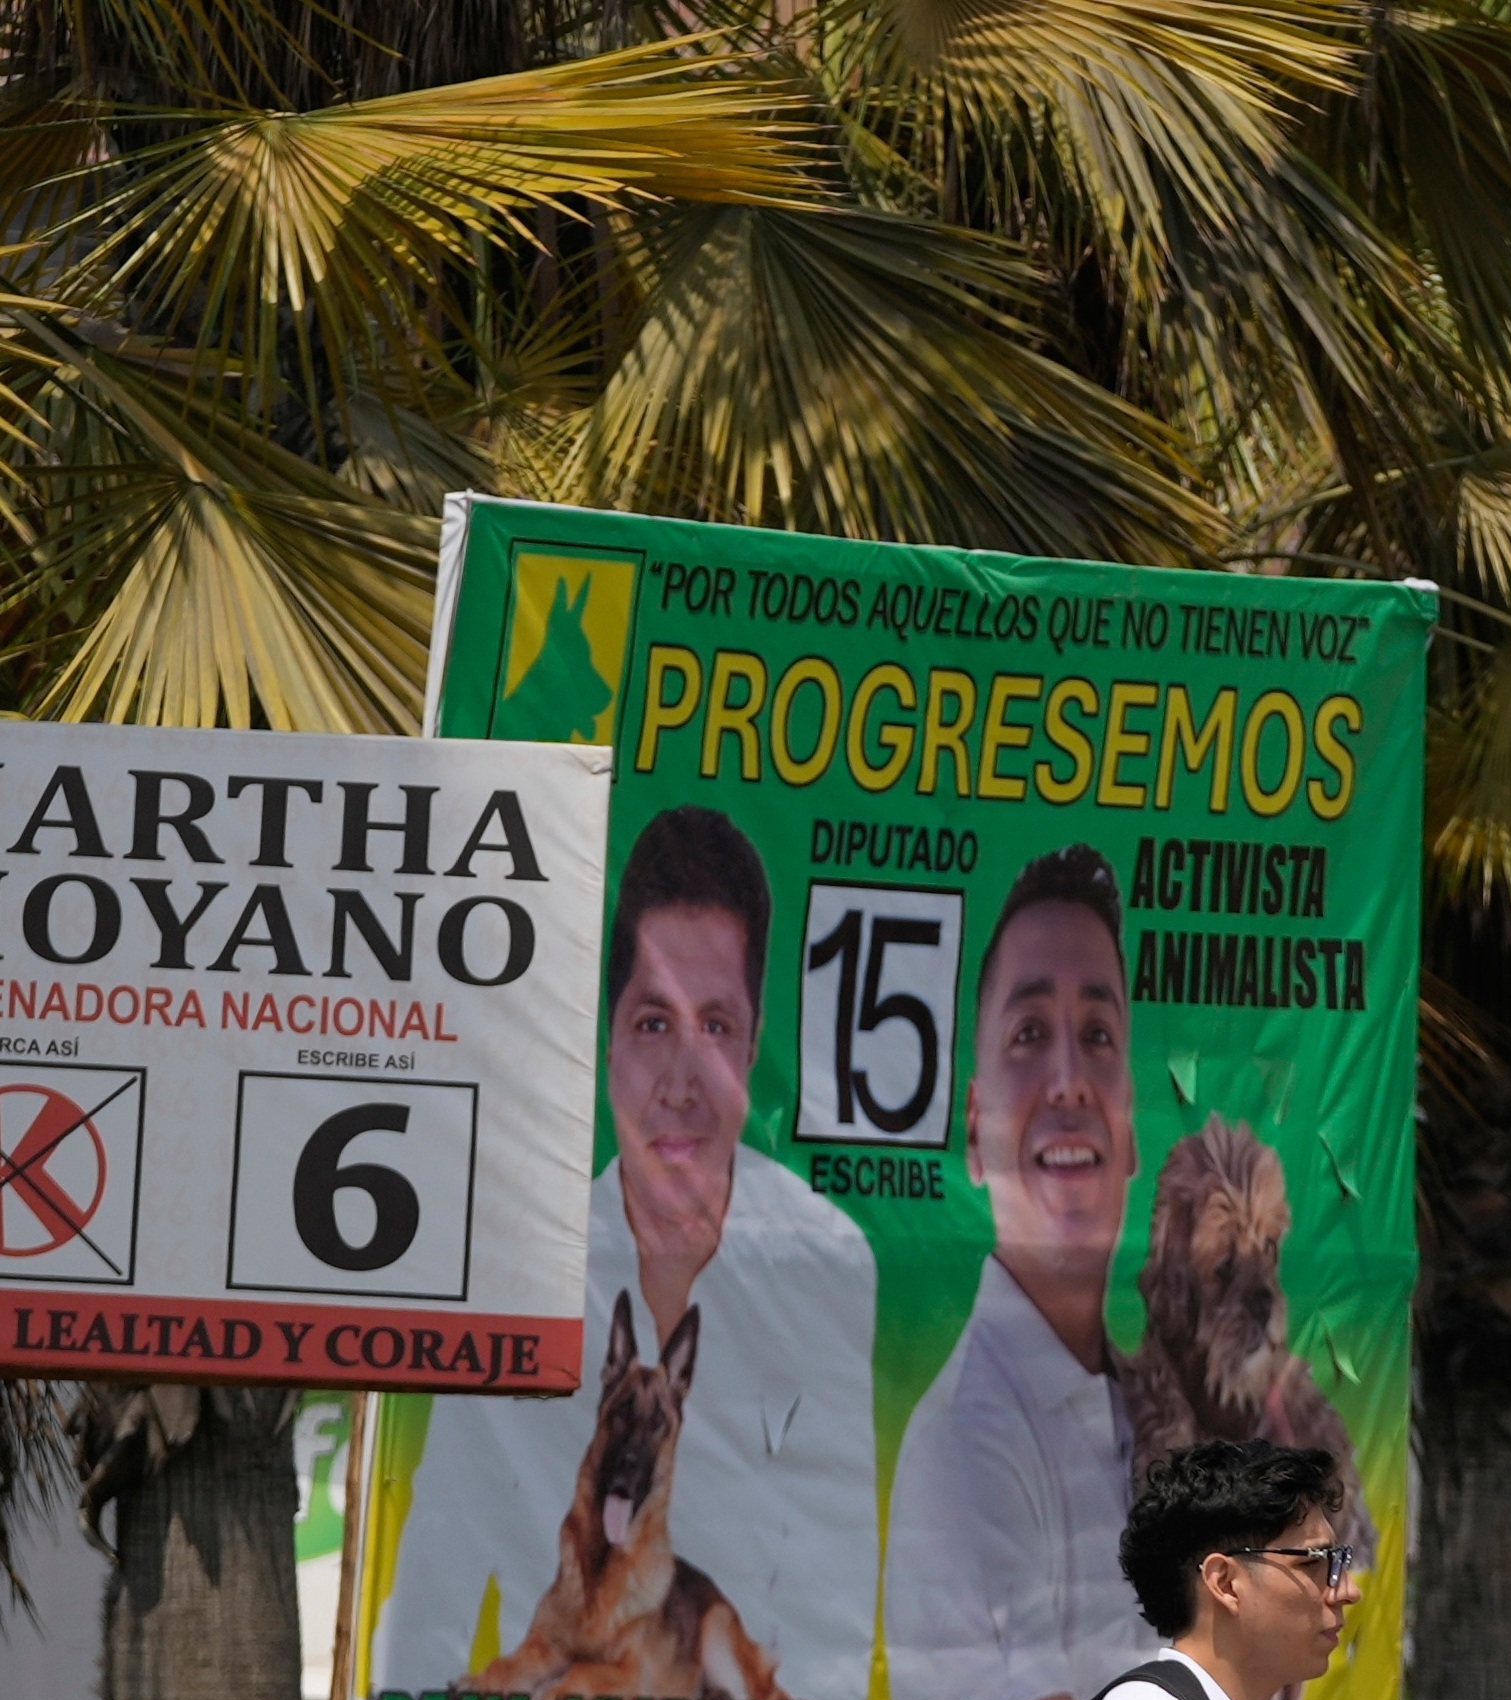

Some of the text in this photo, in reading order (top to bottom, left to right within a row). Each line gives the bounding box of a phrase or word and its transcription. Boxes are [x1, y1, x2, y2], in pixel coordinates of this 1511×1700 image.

[747, 570, 862, 627] TODOS
[867, 583, 1038, 645] AQUELLOS
[1046, 596, 1112, 654] QUE
[1120, 601, 1168, 652] NO
[1178, 606, 1290, 661] TIENEN
[636, 643, 1364, 821] PROGRESEMOS
[0, 764, 550, 883] ARTHA
[810, 818, 979, 874] DIPUTADO
[1129, 837, 1326, 920] ACTIVISTA
[0, 872, 537, 988] OYANO
[0, 980, 459, 1043] NADORA NACIONAL
[1132, 931, 1367, 1012] ANIMALISTA
[46, 1036, 80, 1058] ASÍ
[297, 1048, 416, 1071] ESCRIBE ASÍ
[808, 908, 945, 1132] 15
[292, 1101, 421, 1273] 6
[811, 1152, 945, 1201] ESCRIBE
[12, 1308, 541, 1384] LEALTAD Y CORAJE
